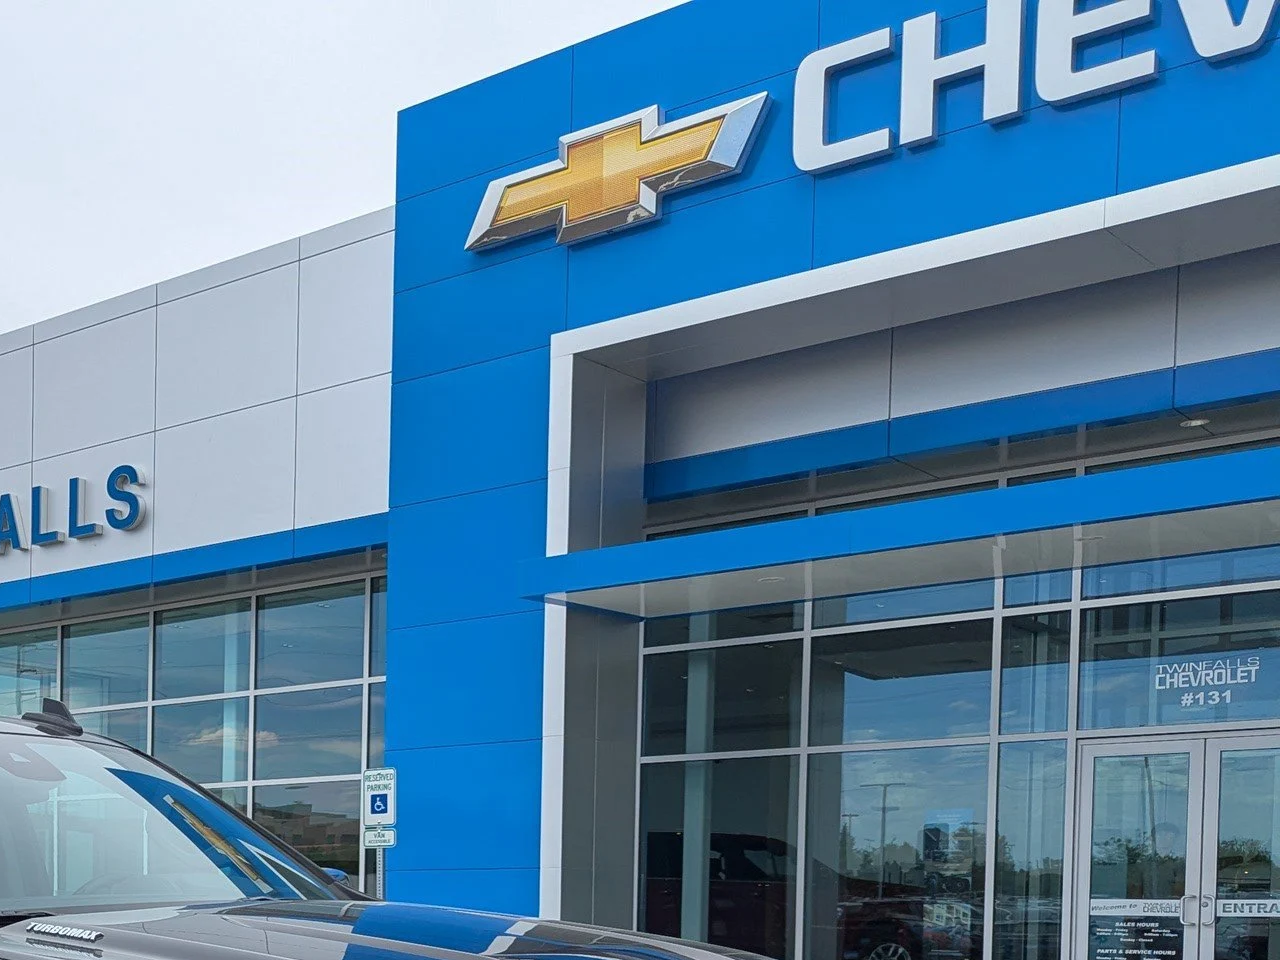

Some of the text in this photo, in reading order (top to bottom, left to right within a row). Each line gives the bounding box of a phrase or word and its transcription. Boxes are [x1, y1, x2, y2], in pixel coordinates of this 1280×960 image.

[1156, 657, 1260, 674] TWINFALLS
[1155, 667, 1260, 690] CHEVROLET
[1180, 690, 1232, 707] #131
[364, 773, 394, 782] RESERVED
[366, 783, 392, 792] PARKING
[1091, 903, 1127, 912] Welcome
[1222, 903, 1280, 914] ENTRA
[26, 921, 104, 942] TURBOMAX
